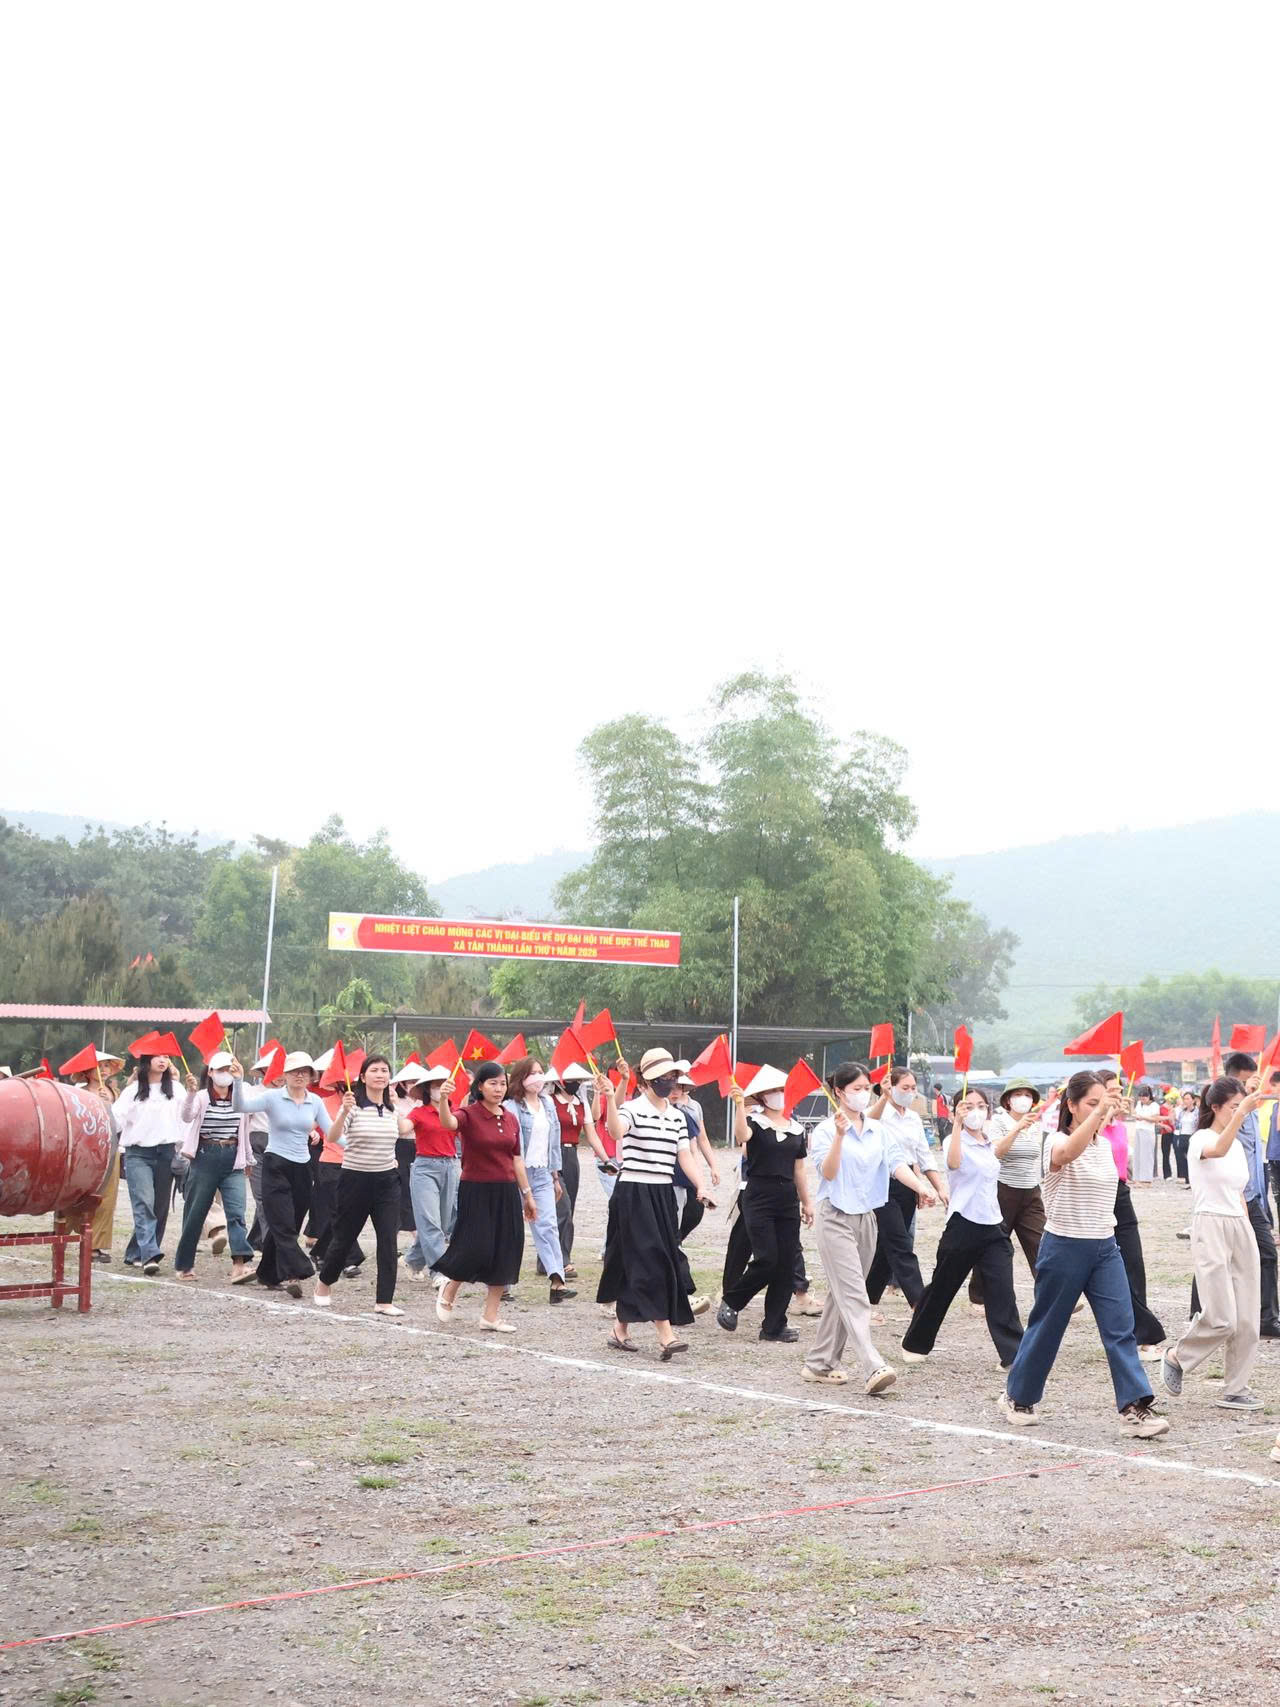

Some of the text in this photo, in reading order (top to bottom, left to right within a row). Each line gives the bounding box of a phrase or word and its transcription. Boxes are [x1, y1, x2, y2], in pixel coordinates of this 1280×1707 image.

[402, 924, 420, 936] LIỆT
[422, 924, 446, 936] CHÀO
[475, 926, 493, 938] CÁC
[650, 938, 670, 949] THAO
